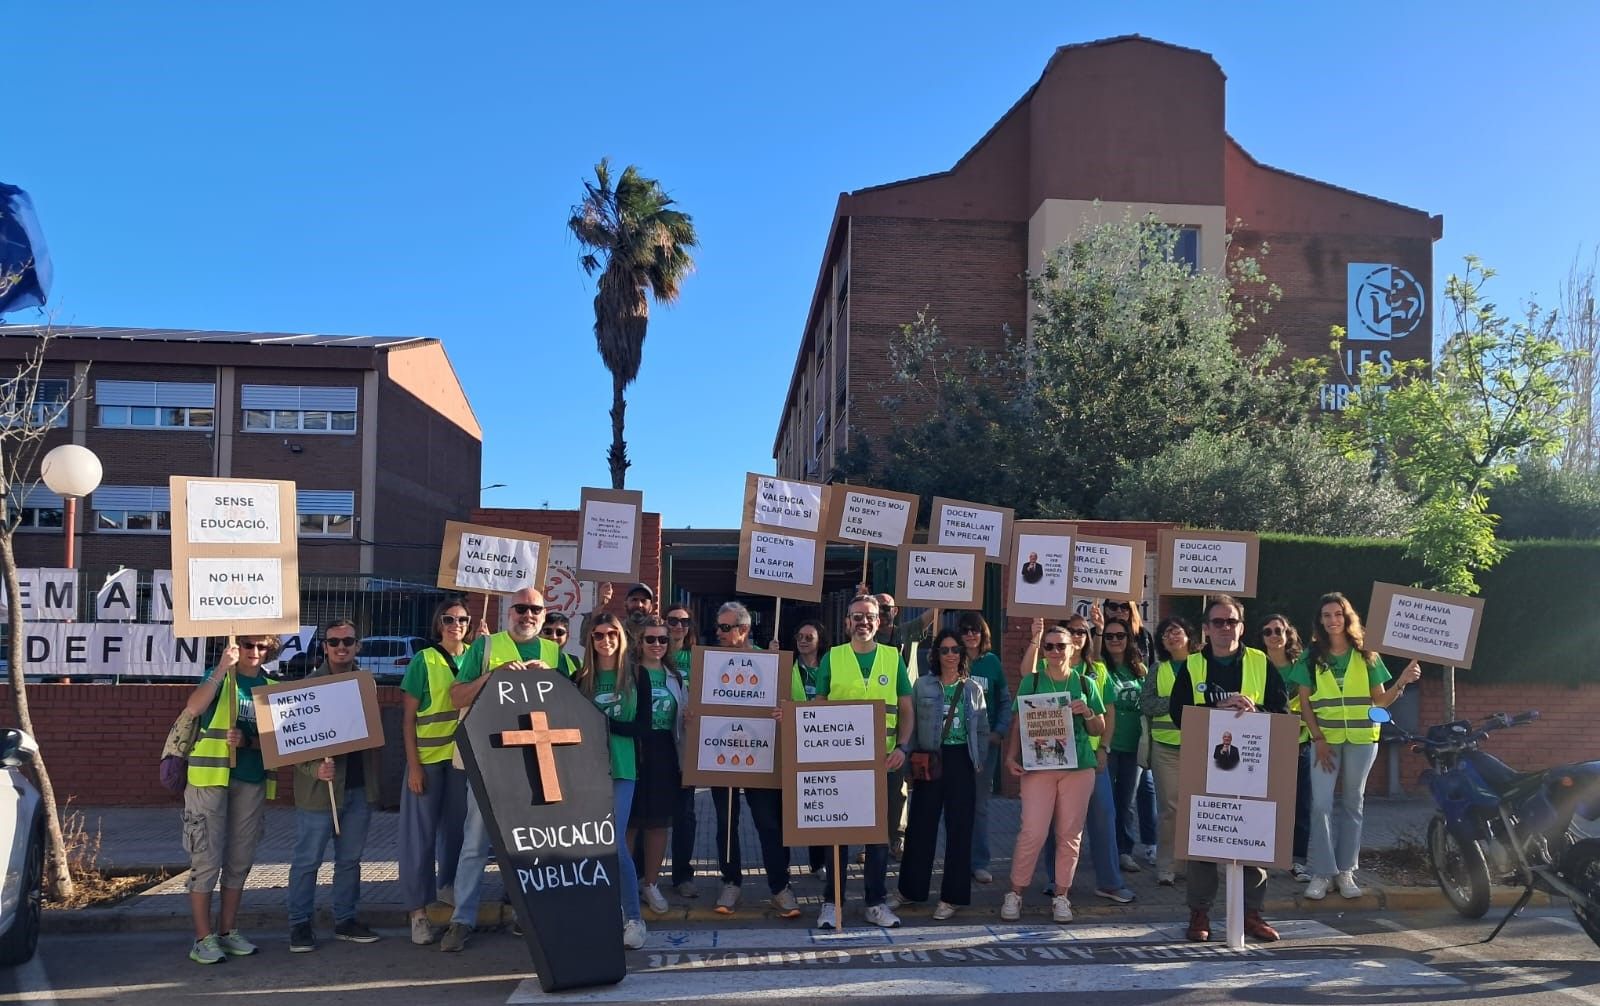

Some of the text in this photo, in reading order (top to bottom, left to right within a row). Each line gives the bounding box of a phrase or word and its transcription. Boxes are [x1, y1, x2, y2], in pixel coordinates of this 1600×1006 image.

[763, 481, 774, 489] EN
[215, 497, 254, 506] SENSE
[851, 496, 905, 511] QUI NO ES MOU
[761, 505, 782, 514] CLAR
[785, 509, 800, 517] QUE
[849, 505, 880, 517] NO SENT
[946, 509, 978, 519] DOCENT
[847, 516, 863, 525] LES
[946, 519, 996, 532] TREBALLANT
[845, 526, 883, 538] CADENES
[944, 529, 991, 542] EN PRECARI
[468, 538, 481, 546] EN
[757, 535, 794, 547] DOCENTS
[756, 546, 767, 554] DE
[1075, 545, 1110, 555] NTRE EL
[755, 557, 795, 569] LA SAFOR
[915, 555, 927, 563] EN
[1179, 552, 1218, 562] PÚBLICA
[464, 565, 527, 579] CLAR QUE SÍ
[754, 567, 794, 580] EN LLUITA
[1083, 566, 1124, 577] DESASTRE
[1191, 565, 1233, 575] QUALITAT
[209, 573, 264, 582] NO HI HA
[1080, 576, 1094, 584] ON
[1095, 578, 1118, 586] VIVIM
[913, 579, 936, 588] CLAR
[937, 581, 955, 589] QUE
[1398, 599, 1452, 615] NO HI HAVIA
[1394, 620, 1450, 637] UNS DOCENTS
[1391, 630, 1460, 650] COM NOSALTRES
[728, 658, 753, 667] A LA
[276, 691, 316, 706] MENYS
[498, 680, 554, 705] RIP
[712, 688, 766, 700] FOGUERA!!
[803, 711, 816, 719] EN
[731, 723, 744, 732] LA
[704, 737, 769, 749] CONSELLERA
[803, 735, 865, 748] CLAR QUE SÍ
[803, 775, 837, 784] MENYS
[1197, 800, 1243, 811] LLIBERTAT
[1197, 811, 1244, 822] EDUCATIVA
[512, 813, 615, 852] EDUCACIÓ
[1196, 834, 1267, 848] SENSE CENSURA
[517, 857, 611, 894] PÚBLICA
